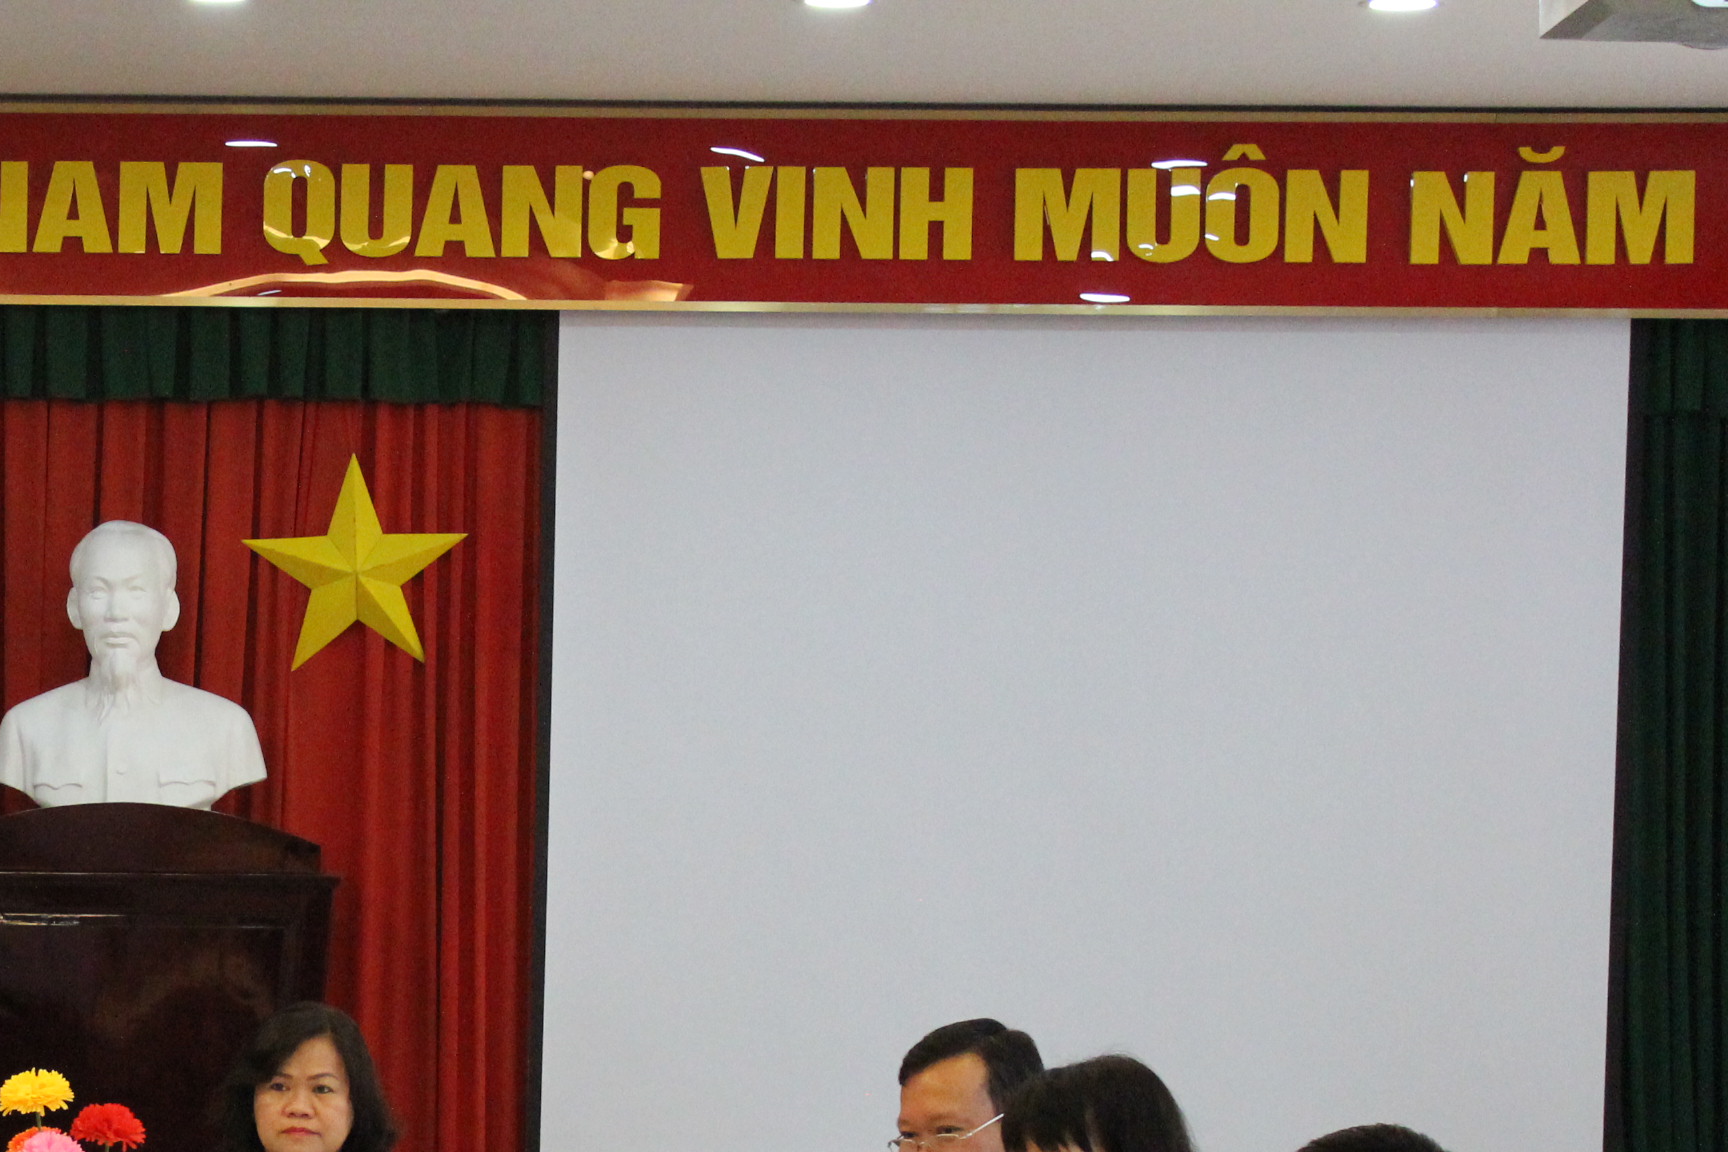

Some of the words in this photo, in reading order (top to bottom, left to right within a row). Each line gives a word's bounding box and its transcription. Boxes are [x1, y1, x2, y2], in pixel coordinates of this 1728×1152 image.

[263, 161, 661, 266] QUANG
[700, 166, 973, 262] VINH
[1013, 143, 1371, 264] MUÔN
[1409, 145, 1696, 266] NĂM
